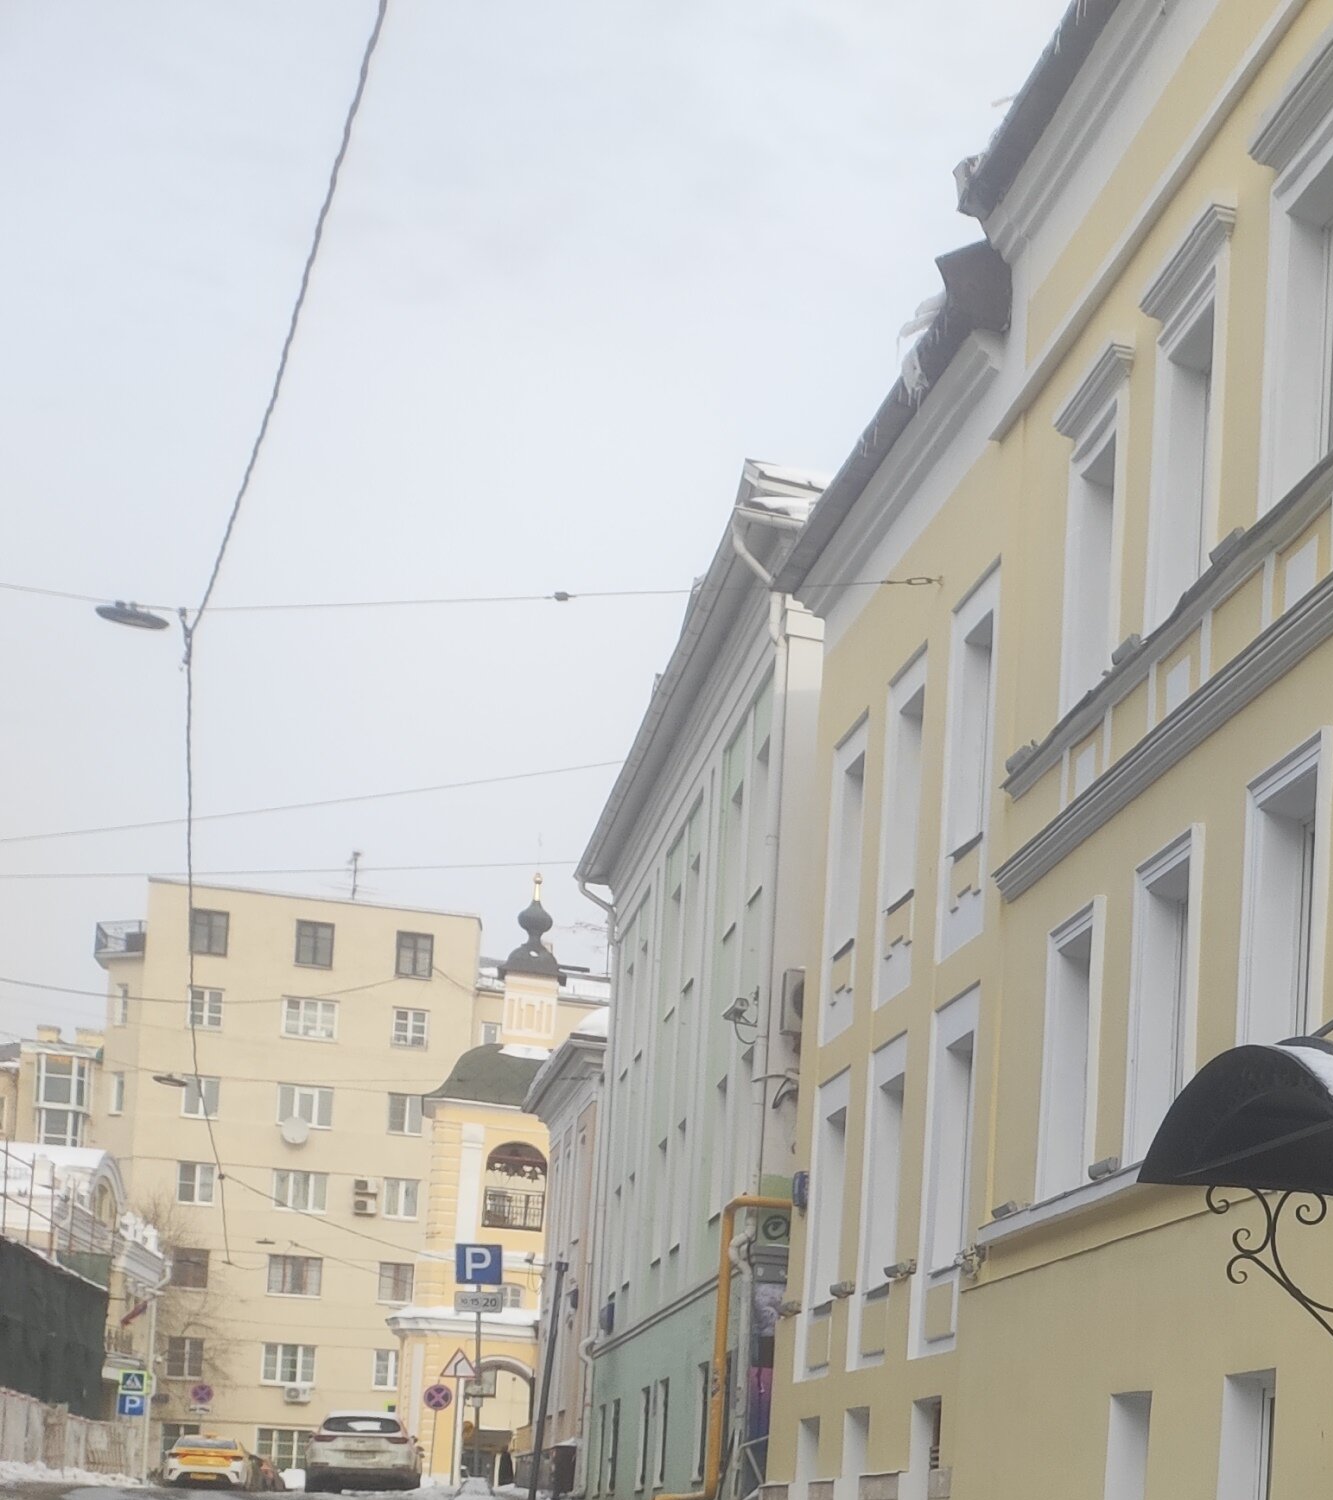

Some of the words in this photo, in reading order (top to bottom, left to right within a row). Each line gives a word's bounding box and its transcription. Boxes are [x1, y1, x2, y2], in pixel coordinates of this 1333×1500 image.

[465, 1247, 492, 1280] P
[482, 1298, 498, 1308] 20
[124, 1396, 141, 1414] P
